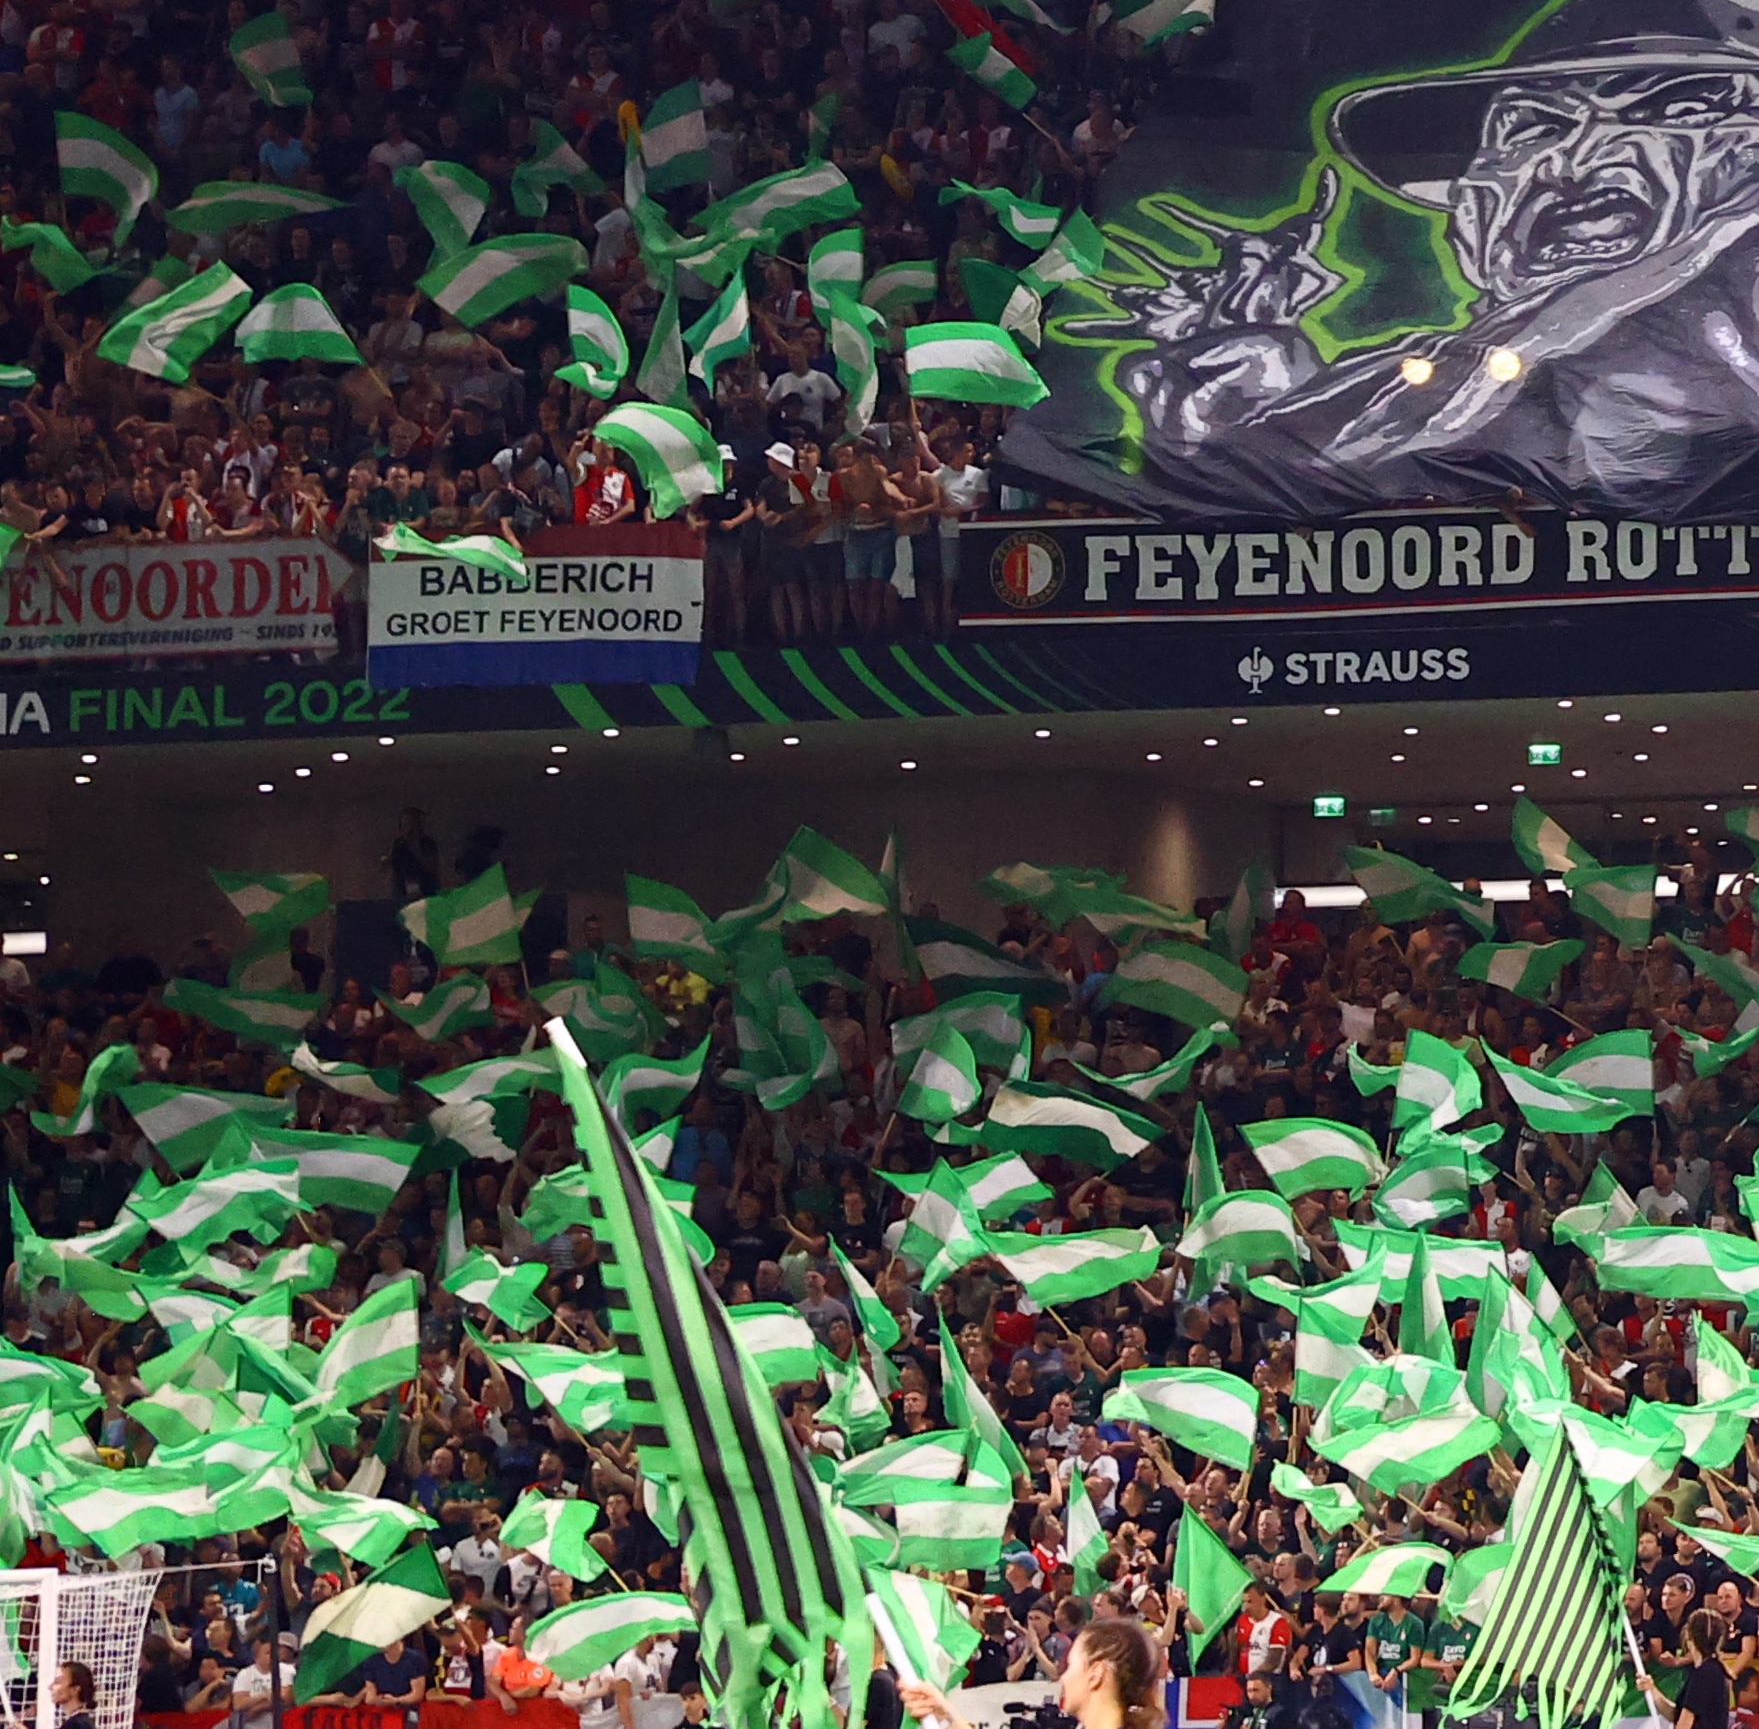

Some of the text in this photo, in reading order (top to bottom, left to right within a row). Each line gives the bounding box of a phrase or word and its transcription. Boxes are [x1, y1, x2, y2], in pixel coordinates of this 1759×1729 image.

[1084, 524, 1535, 601] FEYENOORD
[386, 608, 683, 637] GROET FEYENOORD
[1284, 647, 1471, 686] STRAUSS
[69, 685, 246, 732] FINAL
